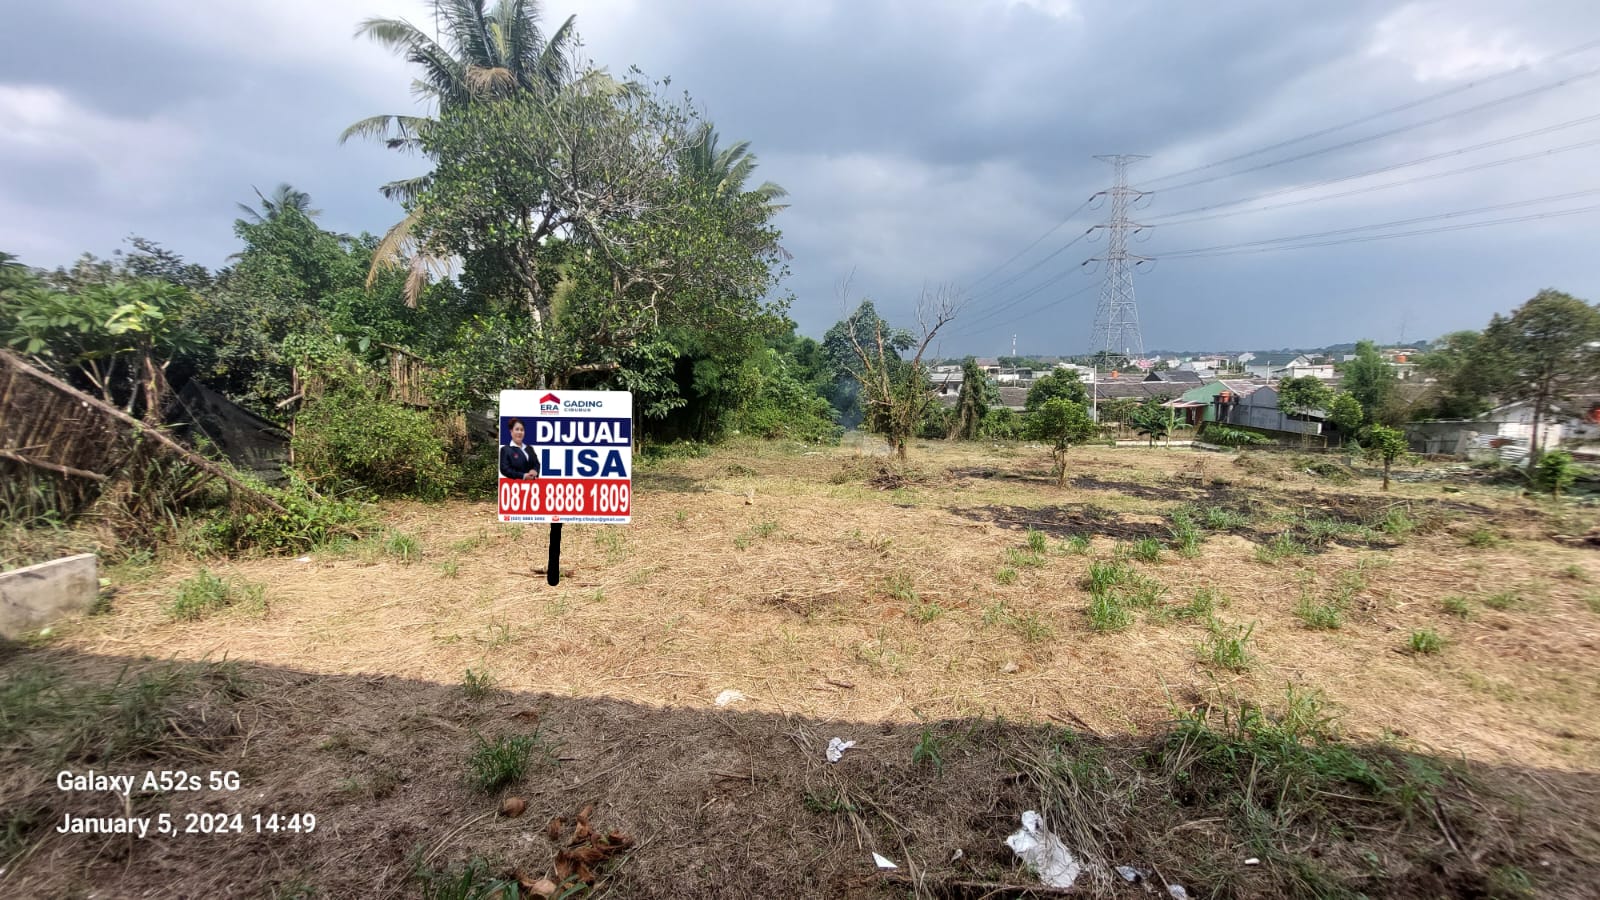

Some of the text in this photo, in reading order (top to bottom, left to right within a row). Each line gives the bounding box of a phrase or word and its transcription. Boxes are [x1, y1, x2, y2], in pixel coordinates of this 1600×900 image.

[563, 400, 603, 408] GADING
[536, 421, 629, 443] DIJUAL
[541, 449, 627, 478] LISA
[500, 482, 629, 512] 0878 8888 1809
